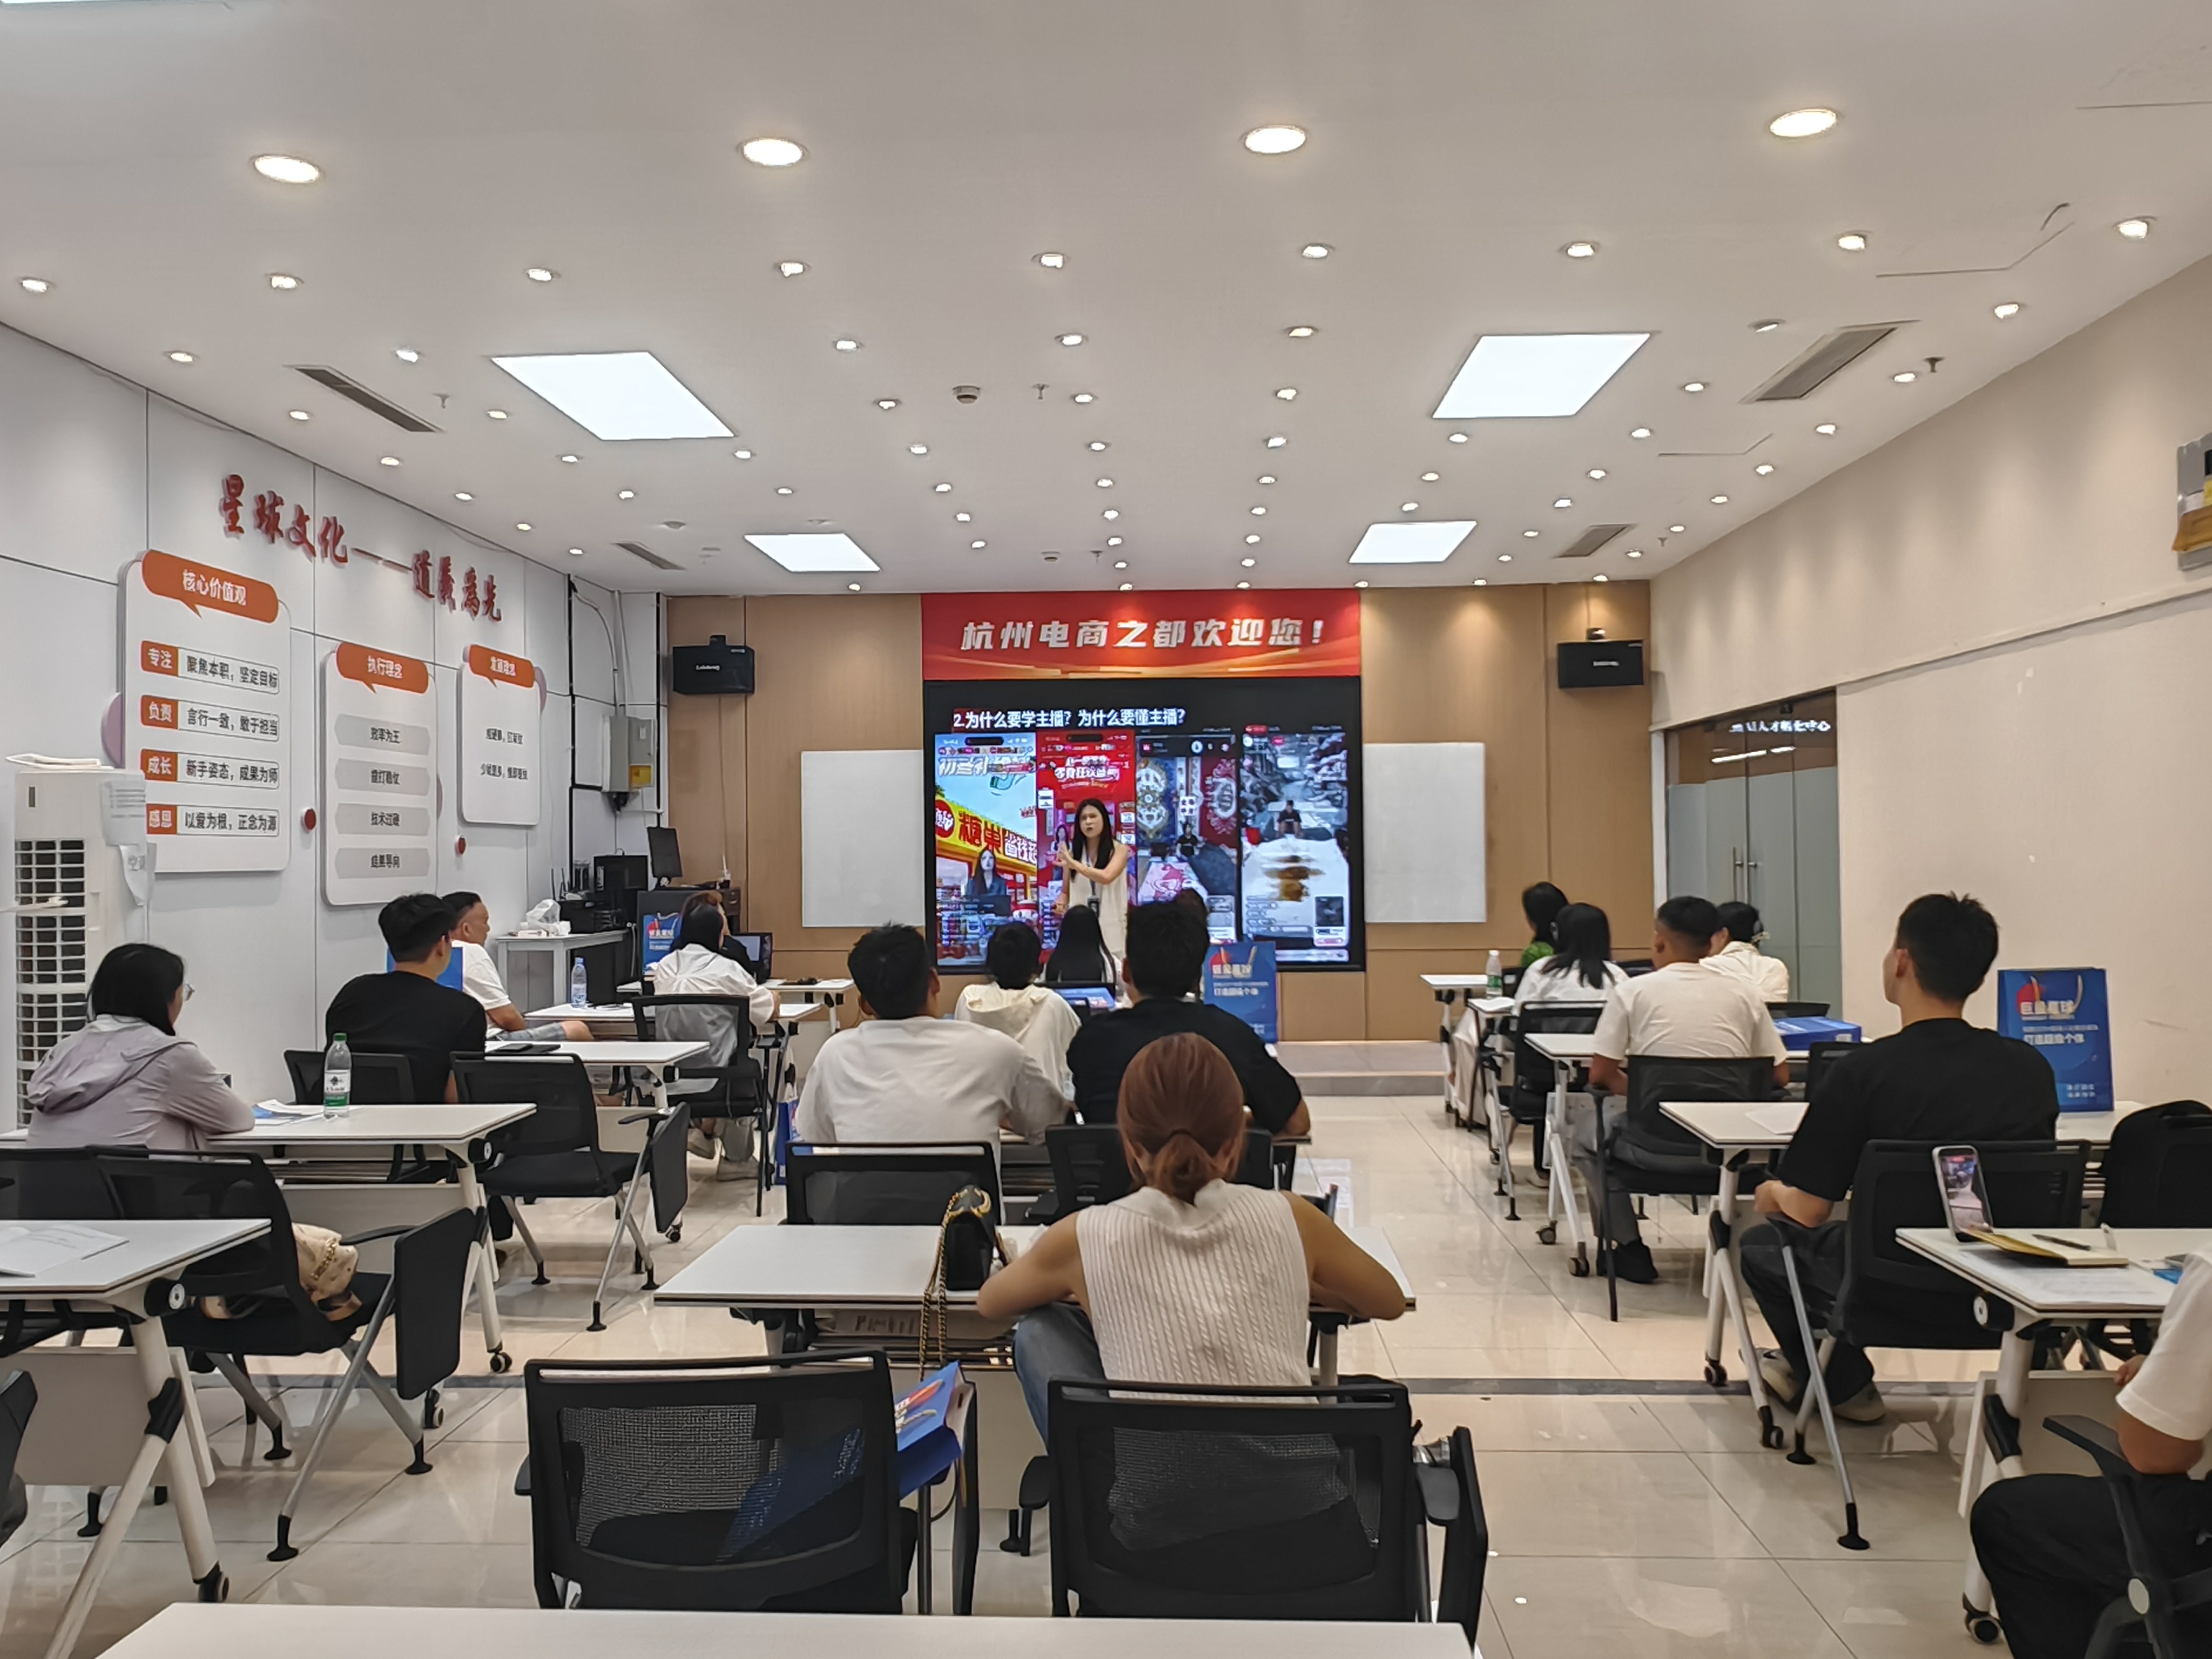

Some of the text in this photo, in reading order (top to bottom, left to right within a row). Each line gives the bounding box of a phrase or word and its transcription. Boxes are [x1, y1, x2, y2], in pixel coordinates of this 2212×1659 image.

[182, 569, 246, 605] 核心价值观
[961, 618, 1323, 651] 杭州电商之都欢迎您！
[148, 648, 278, 687] 专注 聚焦本职，坚定目标
[149, 702, 278, 736] 负责 言行一致，敢于担当
[147, 756, 278, 784] 成长 新手姿态，成果为师
[185, 812, 276, 832] 以爱为根，正念为源
